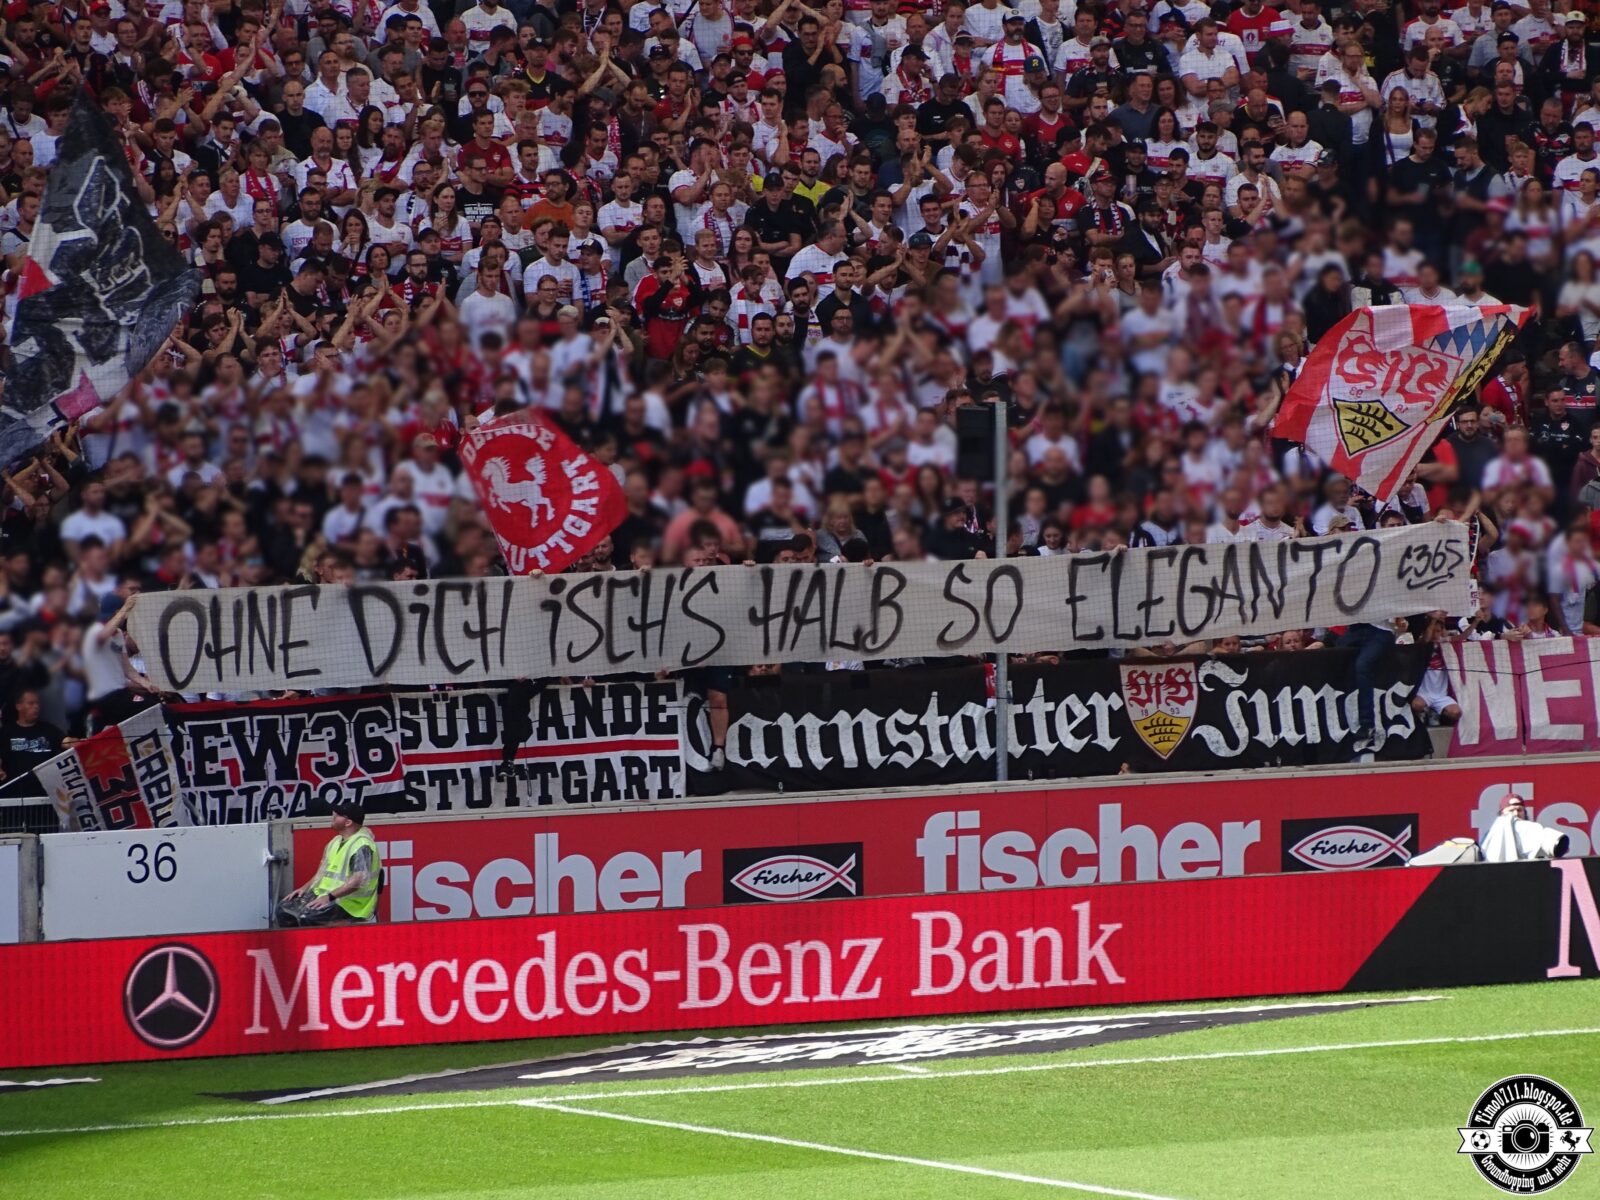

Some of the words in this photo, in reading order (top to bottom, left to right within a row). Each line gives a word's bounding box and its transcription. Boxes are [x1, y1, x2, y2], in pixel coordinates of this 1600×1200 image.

[158, 584, 322, 690] OHNE
[748, 563, 908, 656] HALB
[936, 562, 1024, 650] SO
[1065, 536, 1382, 641] ELEGANTO
[398, 682, 679, 750] SÜDANDE
[1440, 636, 1600, 746] WE
[56, 755, 101, 832] STUTTG
[127, 841, 177, 884] 36
[378, 833, 702, 922] ischer
[753, 868, 826, 886] fischer
[916, 803, 1261, 893] fischer
[1311, 839, 1382, 855] fischer
[244, 922, 883, 1035] Mercedes-Benz
[911, 901, 1126, 997] Bank
